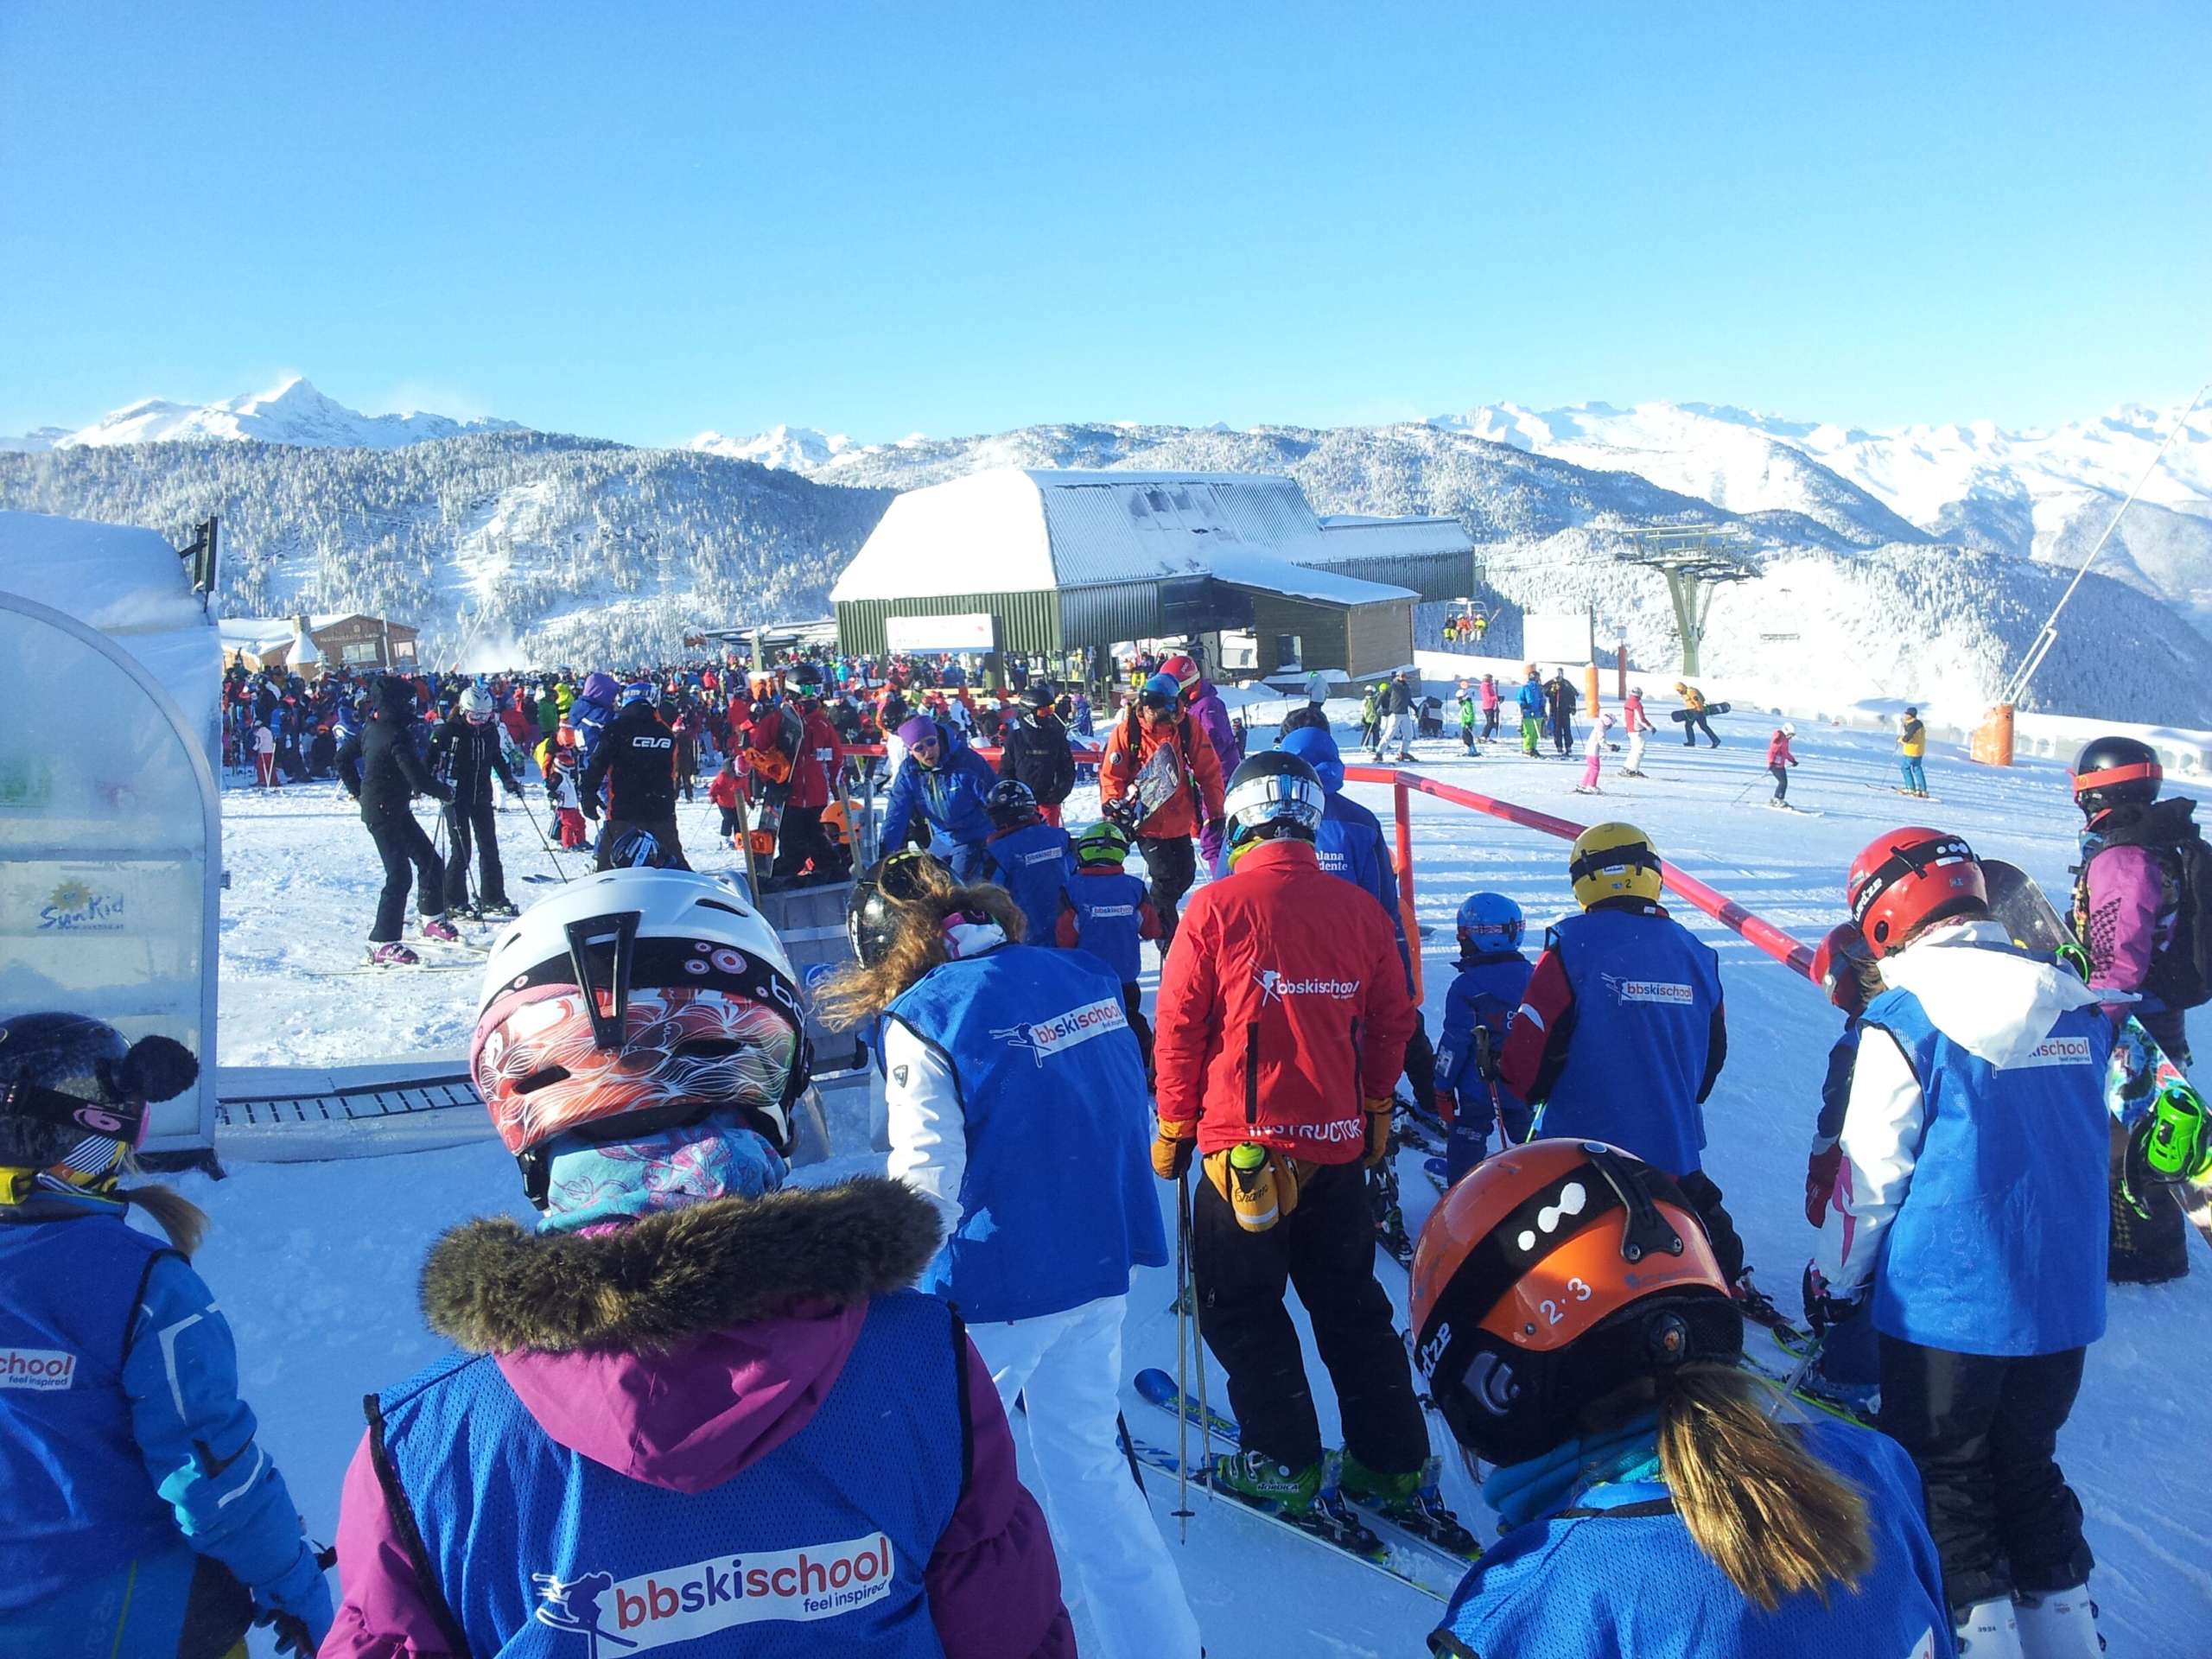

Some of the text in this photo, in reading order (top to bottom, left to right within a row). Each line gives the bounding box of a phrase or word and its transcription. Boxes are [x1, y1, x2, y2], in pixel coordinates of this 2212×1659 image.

[1625, 879, 1632, 888] 2
[1627, 983, 1692, 997] bbskischool
[1034, 1001, 1122, 1044] bbskischool
[616, 1535, 888, 1630] bbskischool
[803, 1580, 888, 1612] feel inspired
